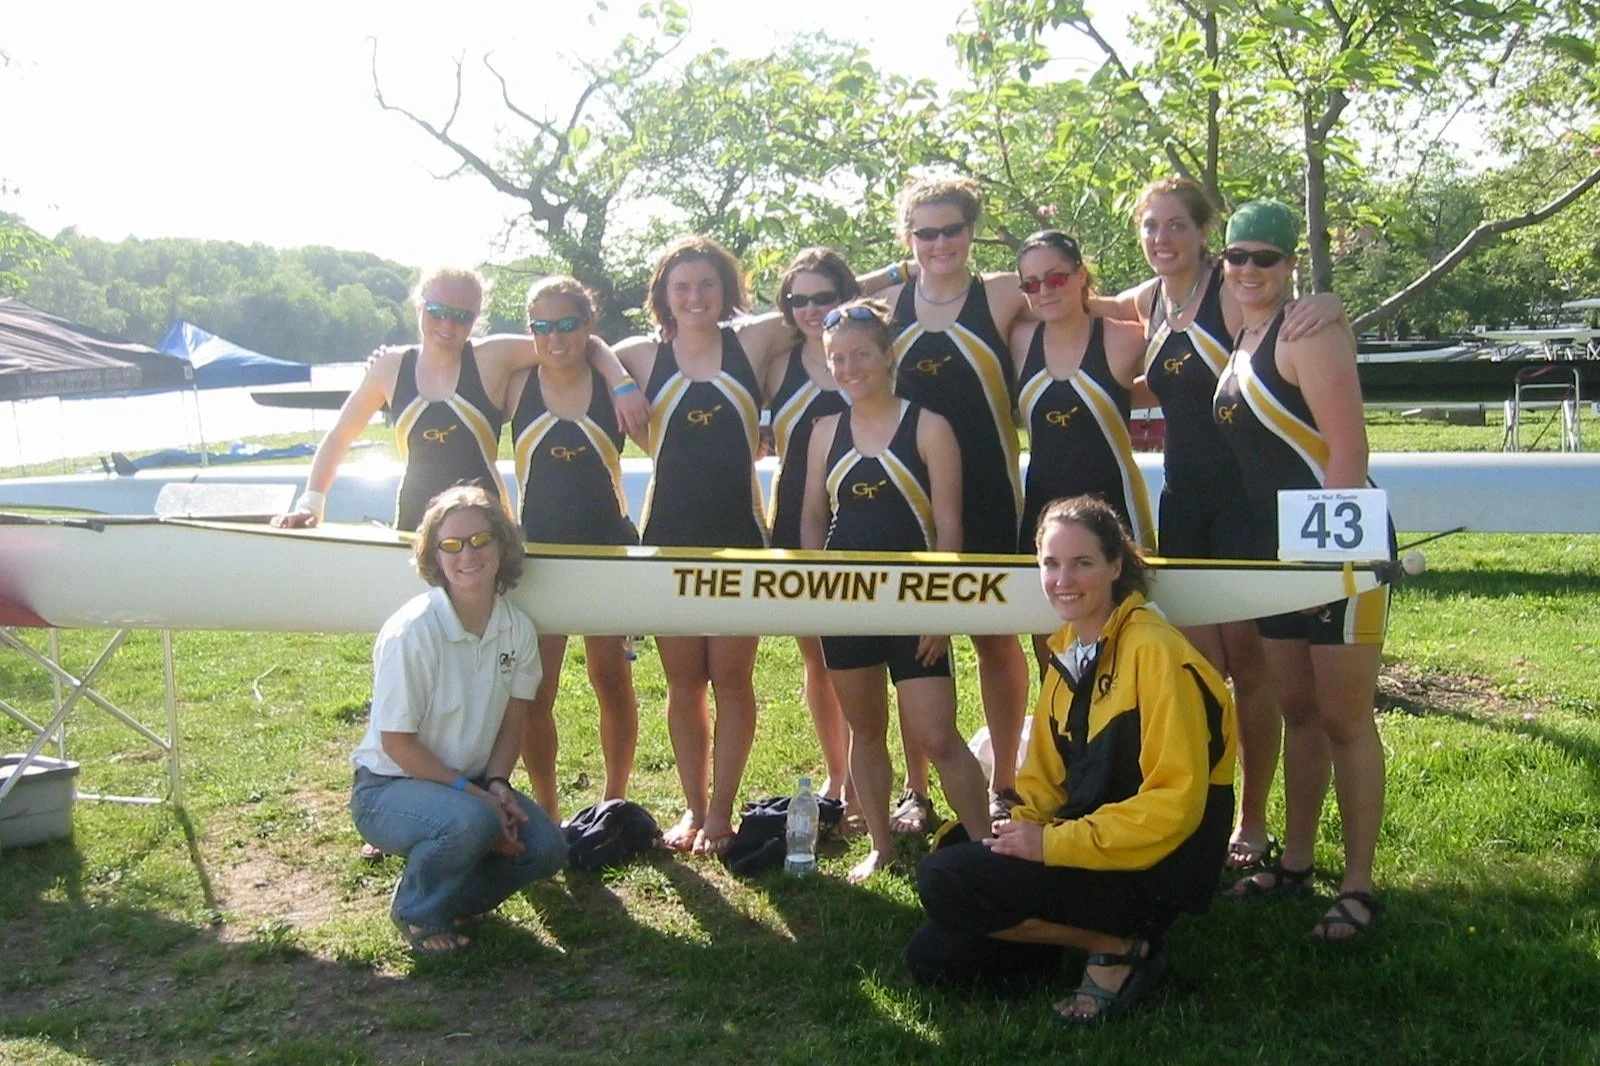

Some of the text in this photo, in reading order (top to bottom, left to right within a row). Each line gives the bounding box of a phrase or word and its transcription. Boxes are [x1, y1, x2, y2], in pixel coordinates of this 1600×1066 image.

[917, 359, 943, 375] GT
[1164, 358, 1184, 375] GT
[687, 410, 714, 426] GT
[1046, 410, 1070, 426] GT
[423, 428, 448, 443] GT
[551, 446, 576, 461] GT
[852, 482, 879, 498] GT
[1300, 502, 1364, 549] 43
[673, 568, 1008, 603] THE ROWIN' RECK
